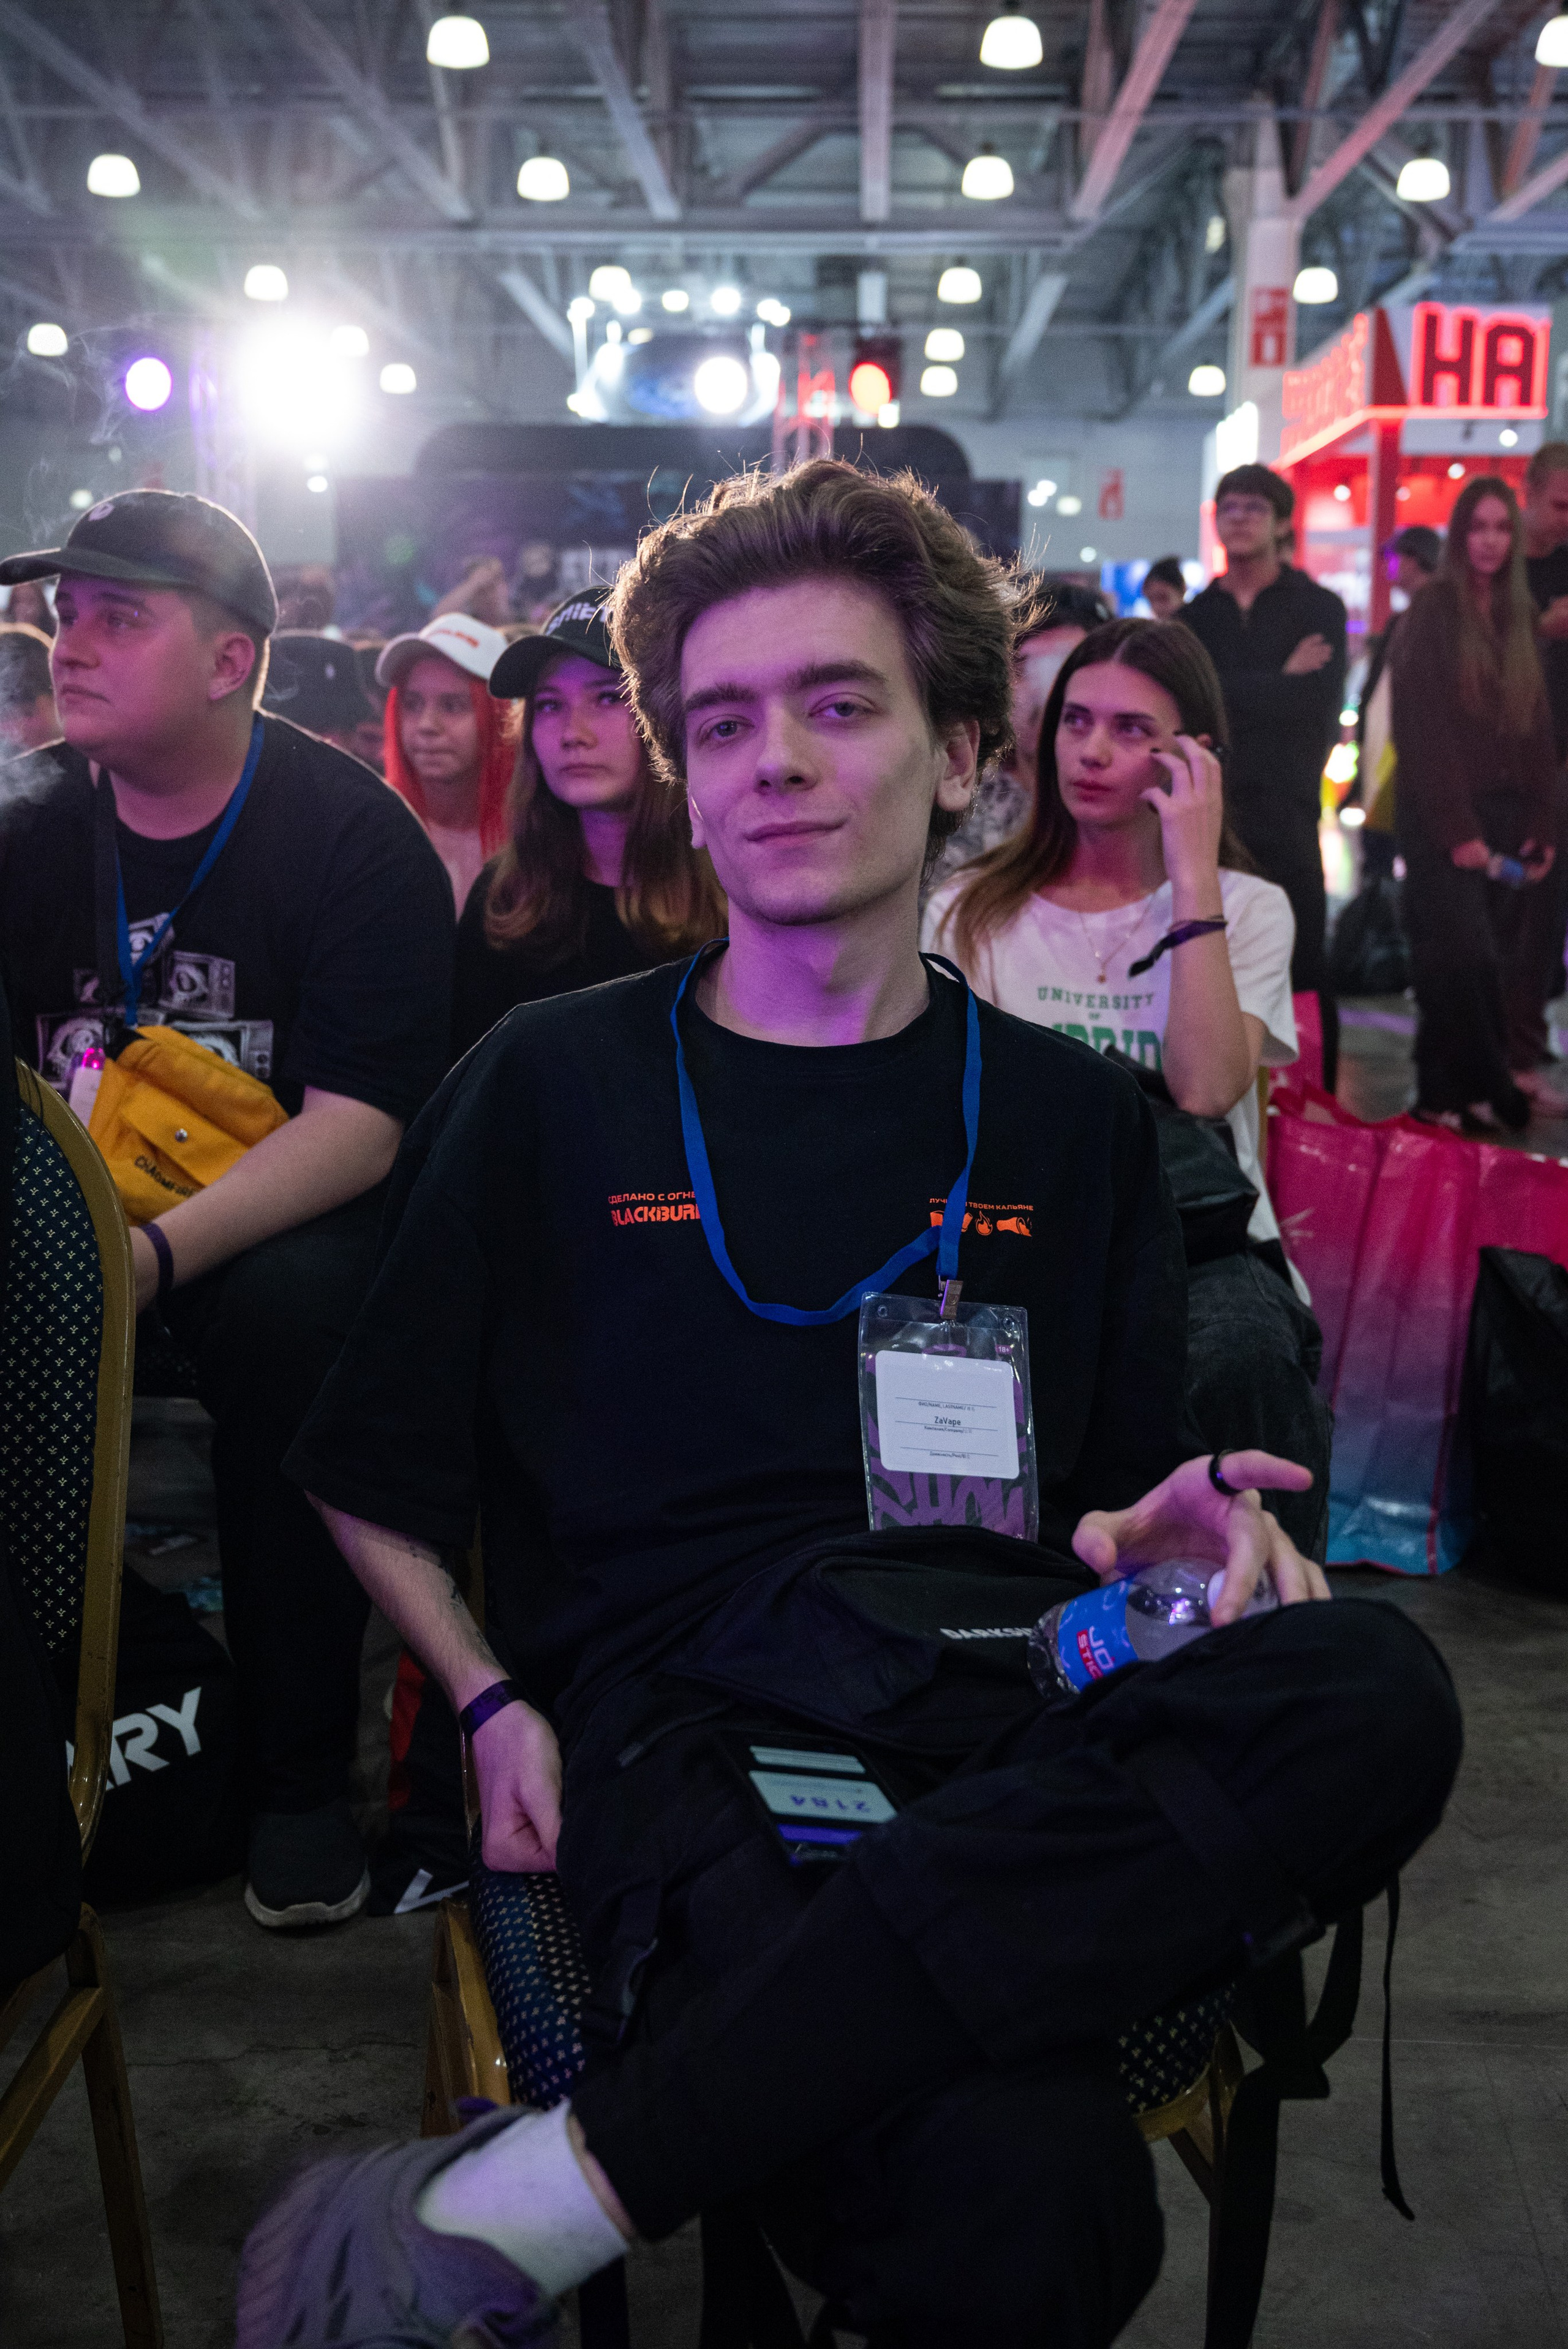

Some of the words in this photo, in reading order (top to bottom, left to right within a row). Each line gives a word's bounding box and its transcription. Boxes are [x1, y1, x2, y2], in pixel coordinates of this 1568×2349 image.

[1036, 986, 1154, 1010] UNIVERSITY
[608, 1192, 655, 1205] СДЕЛАНО
[934, 1416, 962, 1427] ZaVape
[1088, 1625, 1115, 1670] JO
